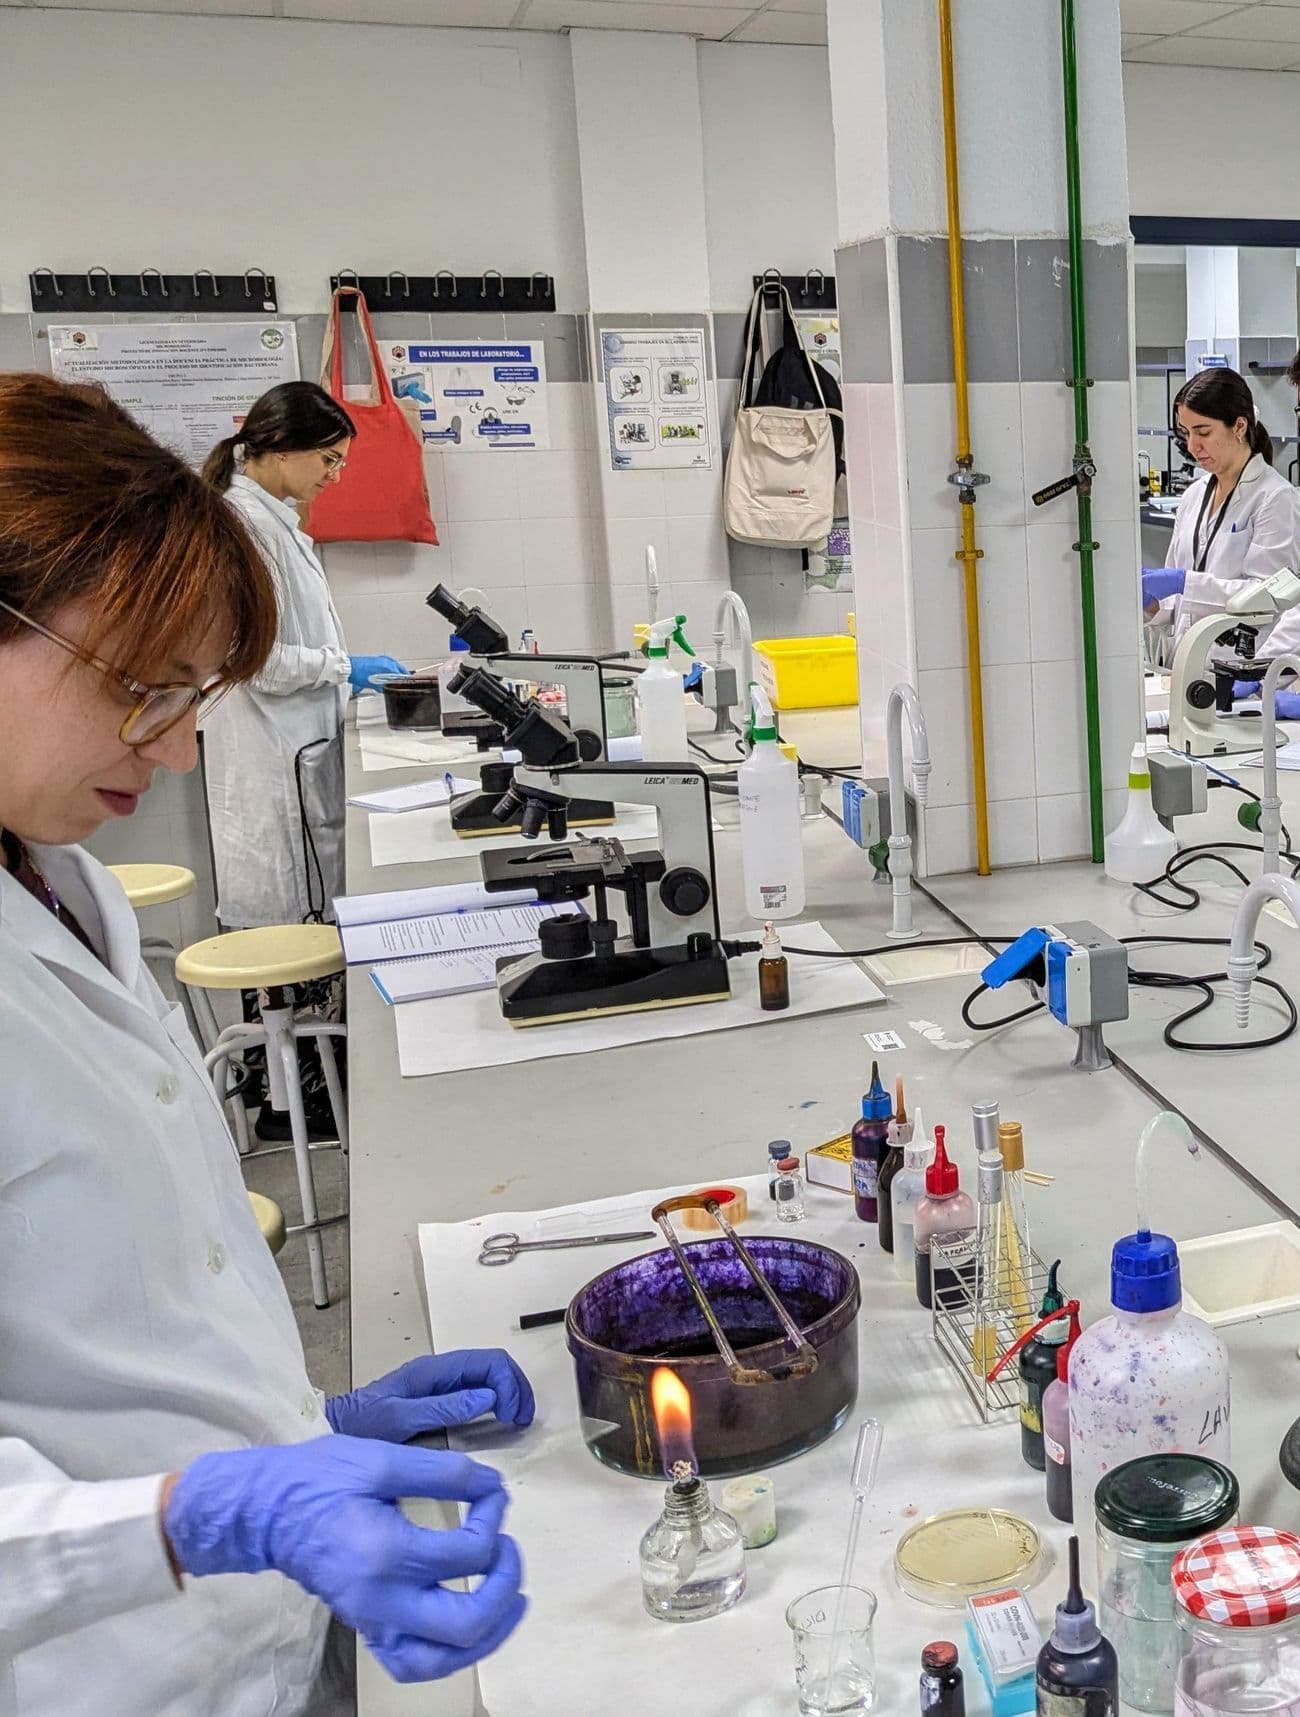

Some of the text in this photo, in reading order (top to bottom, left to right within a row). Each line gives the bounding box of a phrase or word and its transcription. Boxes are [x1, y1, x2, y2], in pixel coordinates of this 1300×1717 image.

[419, 350, 428, 358] EN
[428, 350, 440, 358] LOS
[440, 350, 471, 358] TRABAJOS
[471, 350, 480, 358] DE
[643, 776, 666, 785] LEICA
